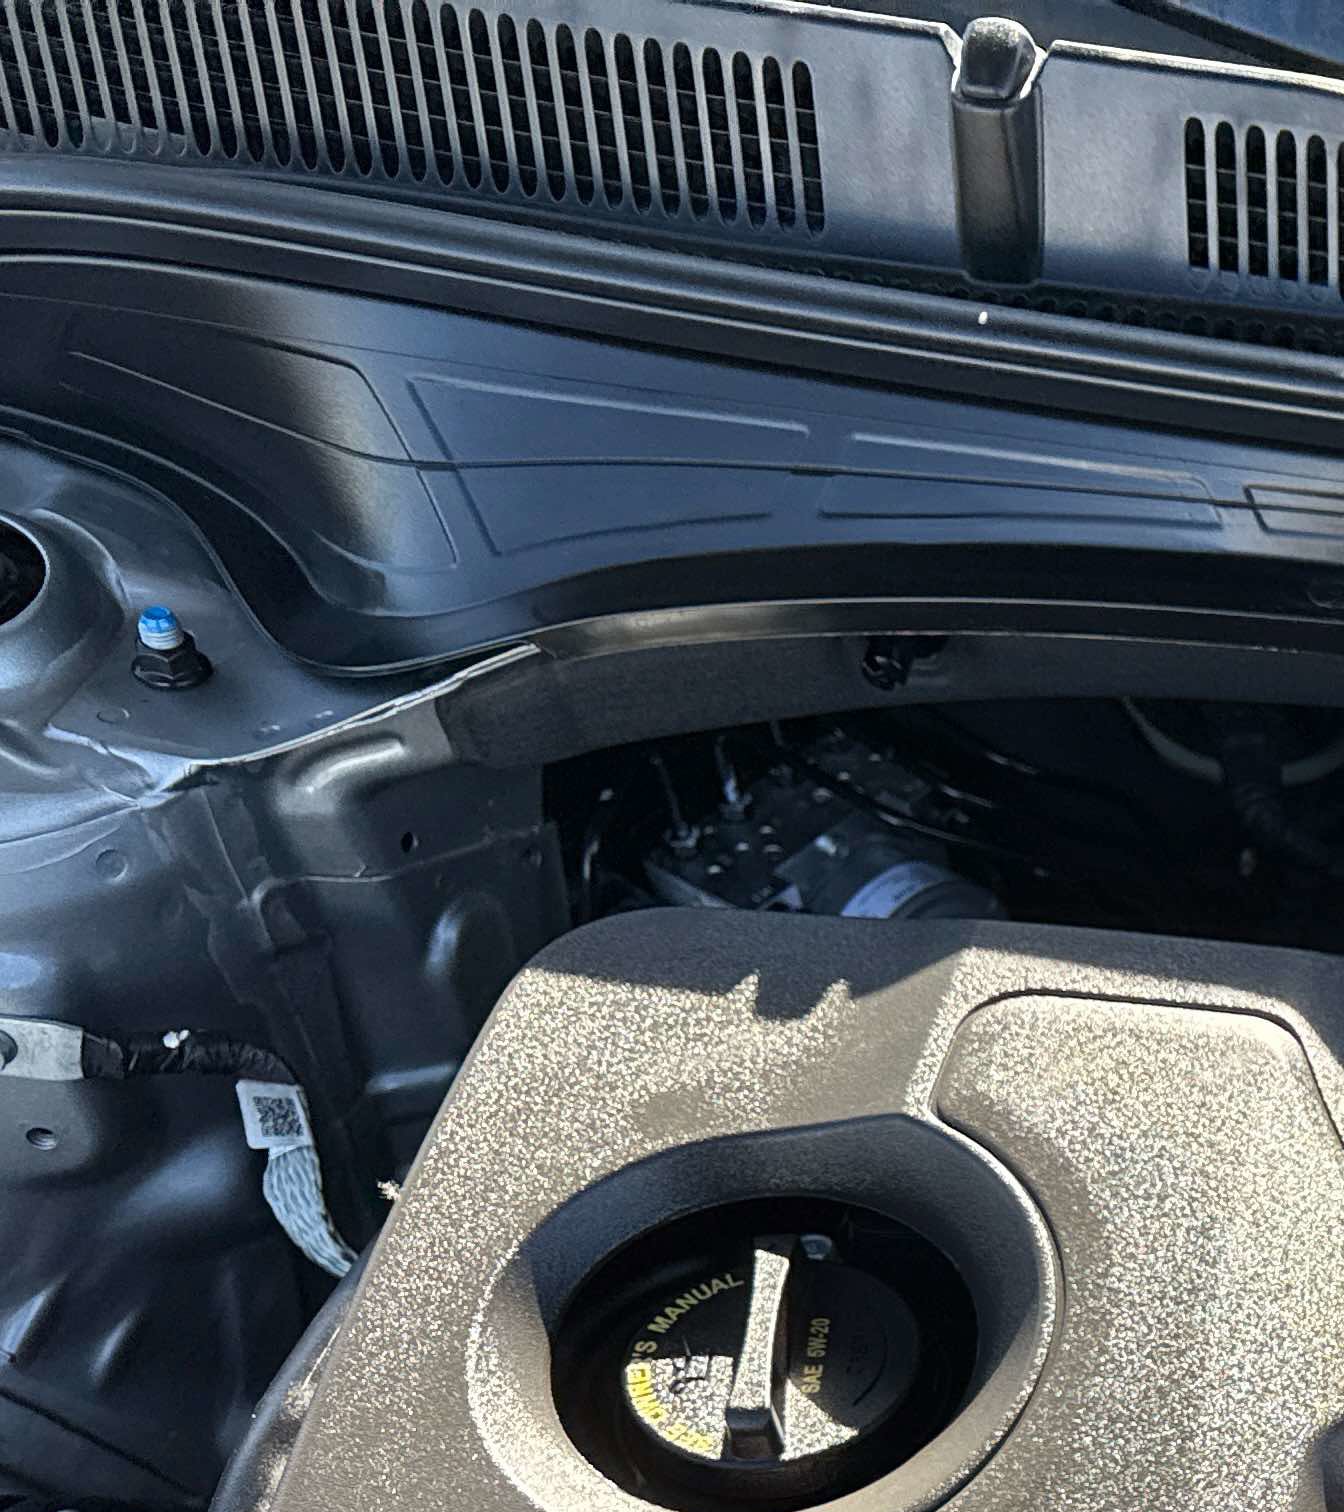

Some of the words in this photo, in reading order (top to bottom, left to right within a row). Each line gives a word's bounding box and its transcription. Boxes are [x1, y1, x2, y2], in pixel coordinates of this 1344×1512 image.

[648, 1273, 744, 1333] MANUAL
[807, 1317, 831, 1358] 5W-20
[801, 1364, 824, 1394] SAE
